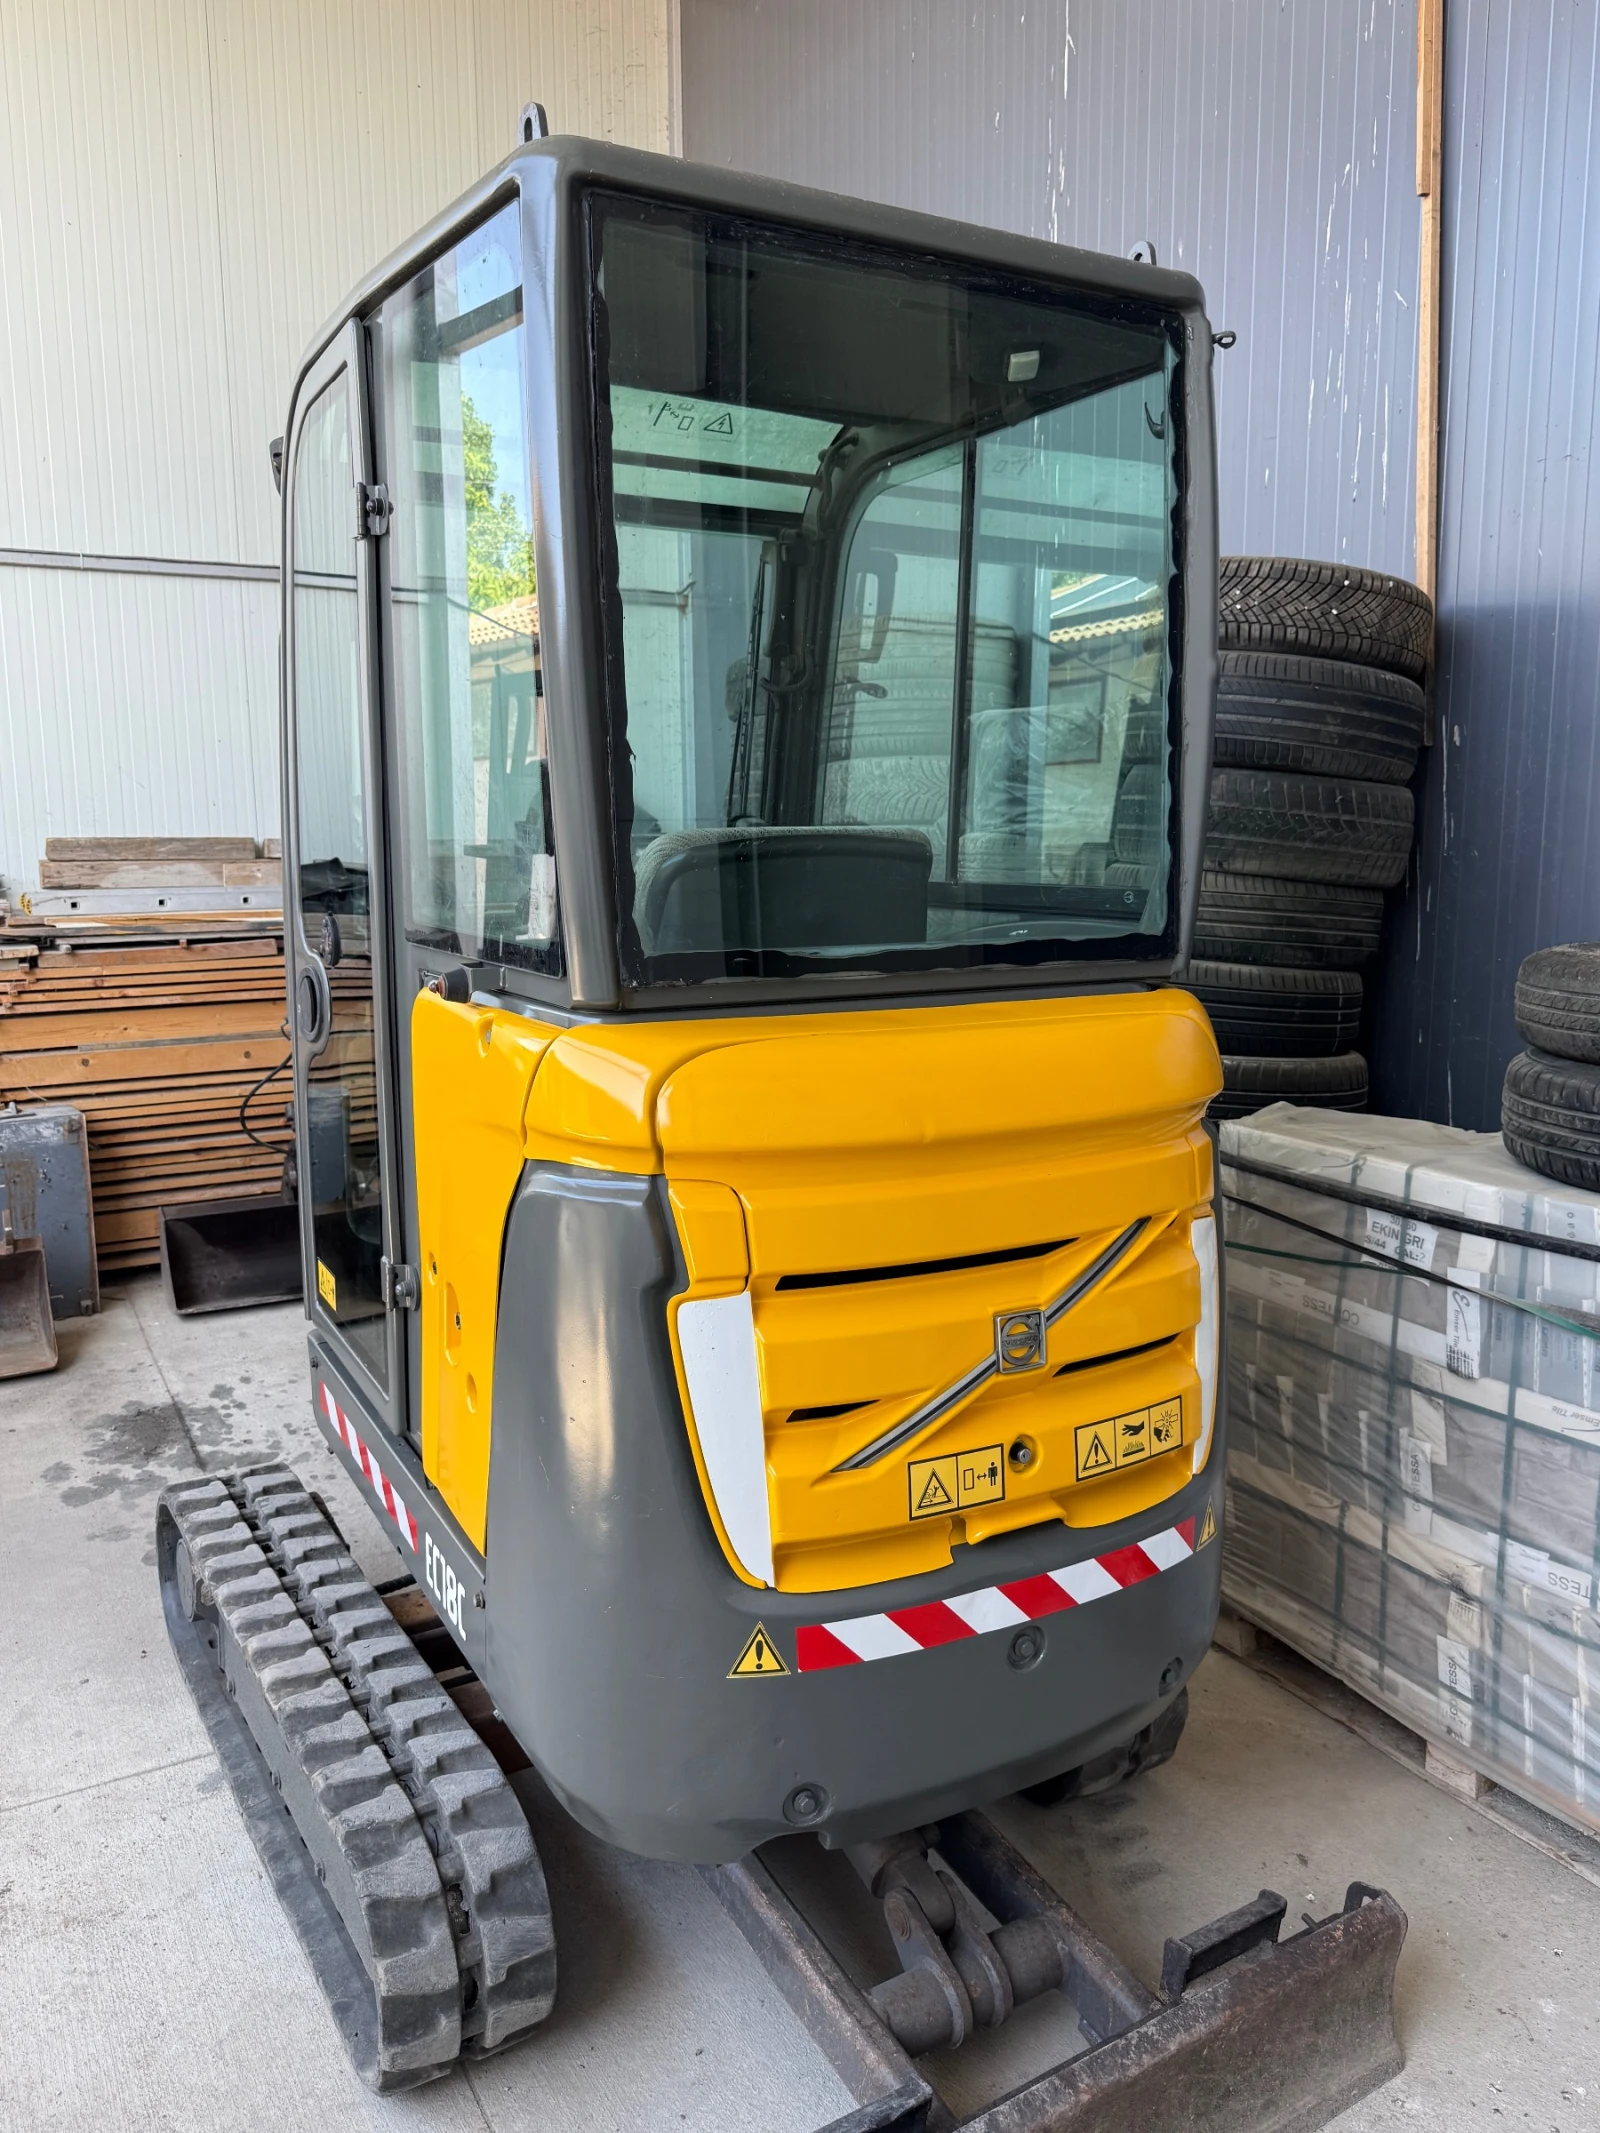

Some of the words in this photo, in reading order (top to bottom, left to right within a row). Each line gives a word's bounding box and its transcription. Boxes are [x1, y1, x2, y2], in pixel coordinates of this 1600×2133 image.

[1389, 1214, 1417, 1232] 3060
[1452, 1309, 1460, 1334] Emser
[1552, 1405, 1568, 1418] Tile
[1570, 1411, 1600, 1428] Emser
[1410, 1453, 1421, 1512] CNTESSA
[425, 1531, 467, 1642] EC18C
